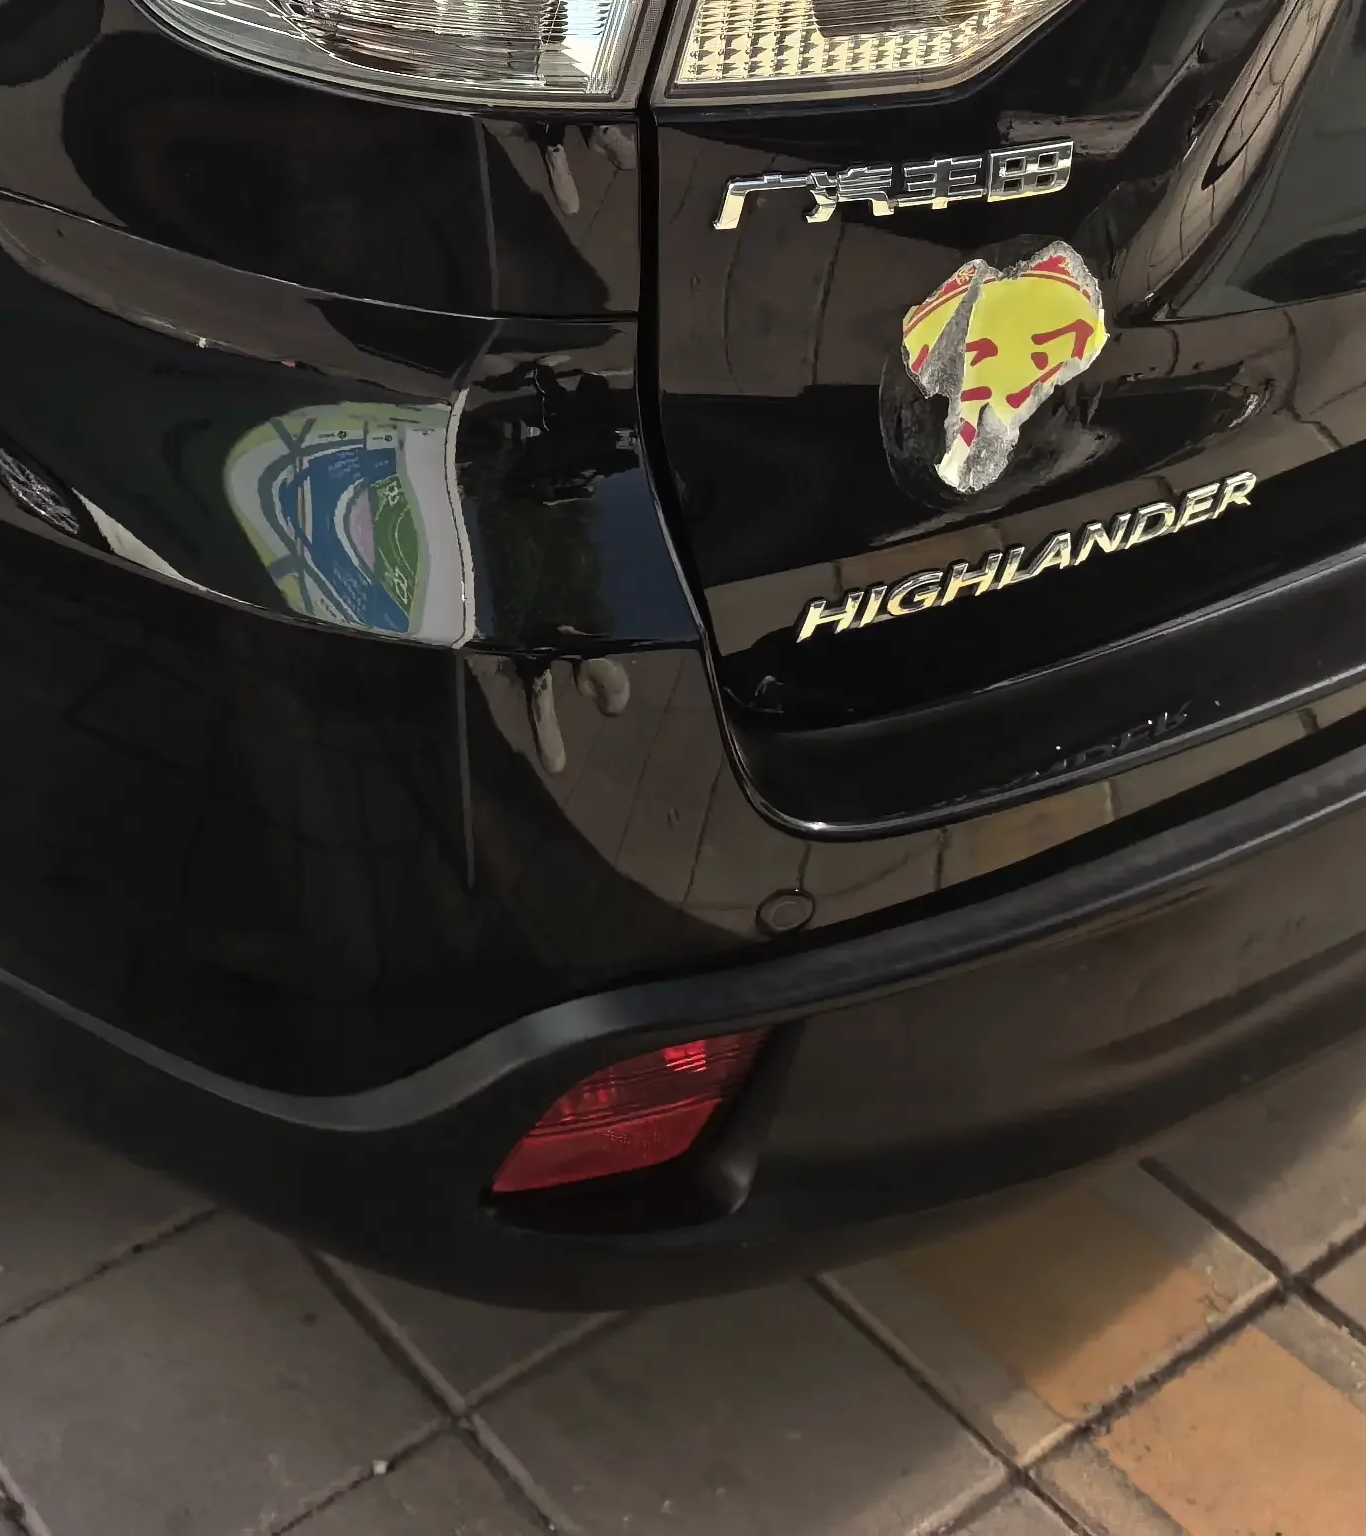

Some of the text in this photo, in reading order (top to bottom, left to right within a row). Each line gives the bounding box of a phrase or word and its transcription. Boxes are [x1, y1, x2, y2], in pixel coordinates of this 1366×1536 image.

[712, 139, 1075, 231] 广汽丰田
[795, 470, 1259, 643] HIGHLANDER
